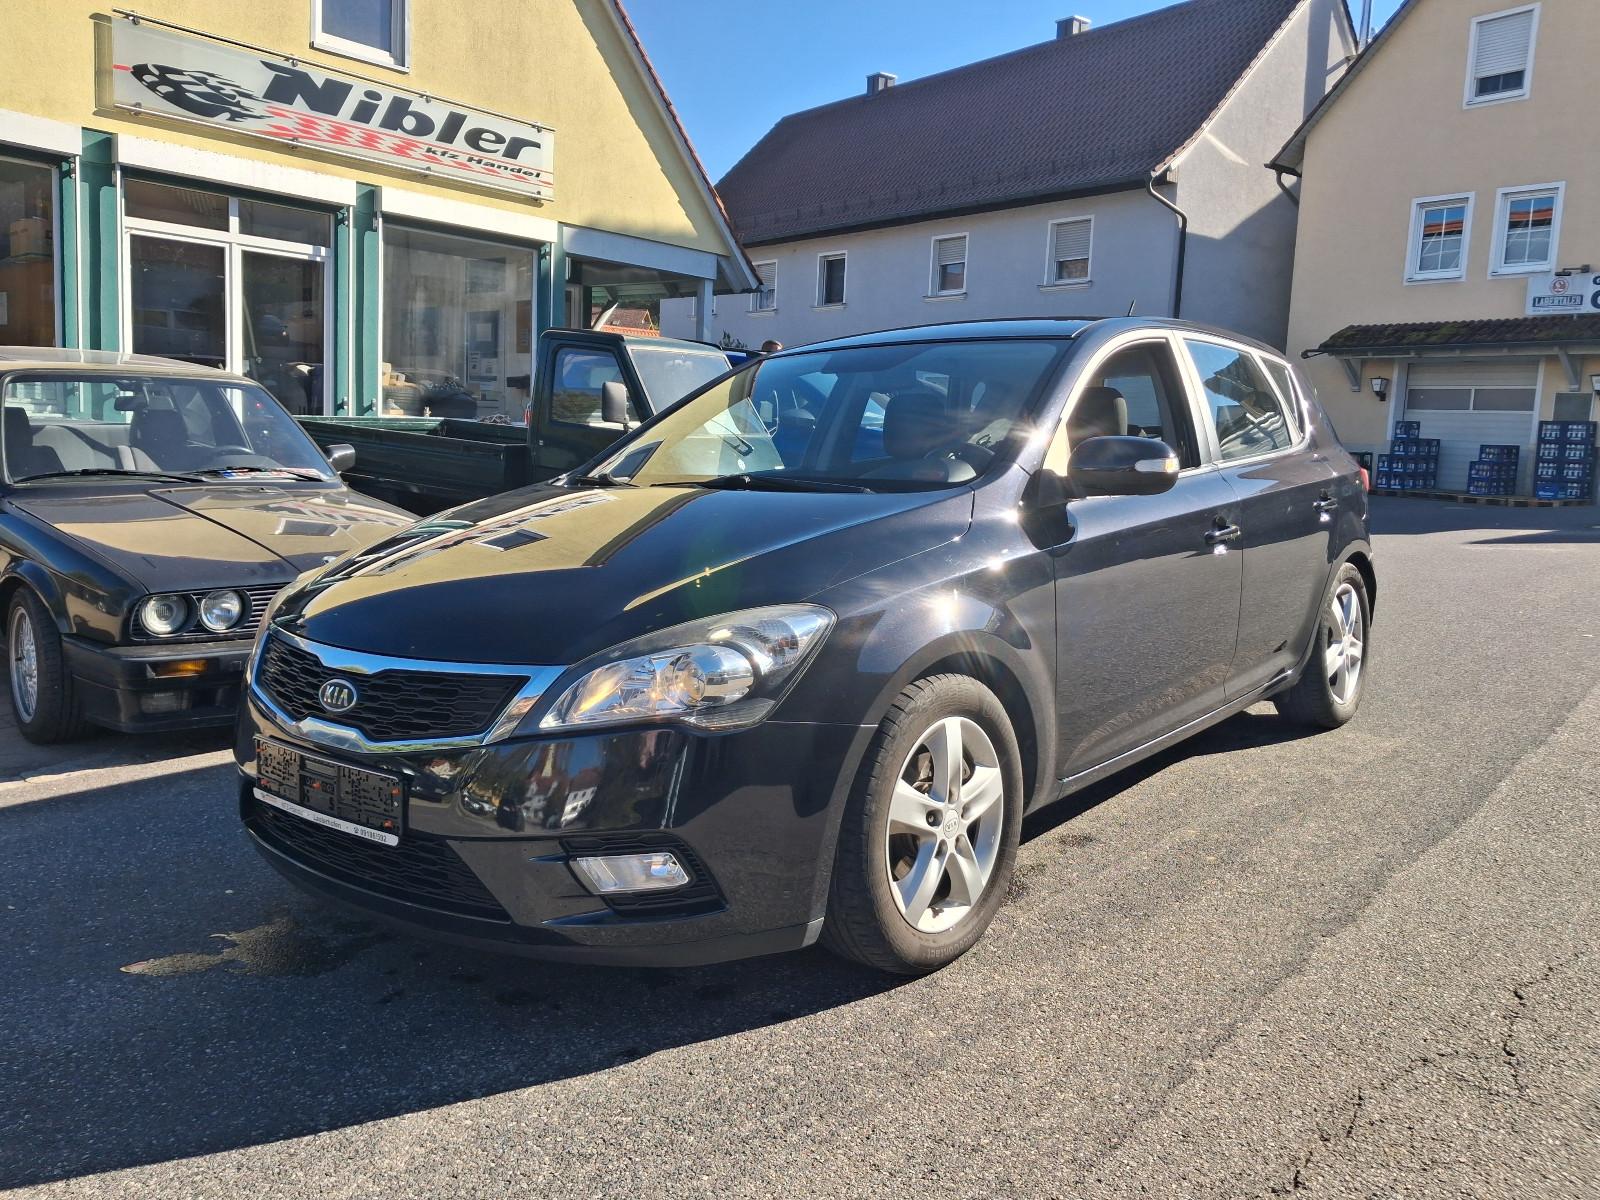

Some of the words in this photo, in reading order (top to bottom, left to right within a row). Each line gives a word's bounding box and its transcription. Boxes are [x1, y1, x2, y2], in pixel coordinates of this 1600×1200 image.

[260, 60, 541, 160] Nibler
[466, 156, 541, 178] Handel
[323, 685, 348, 707] KIA
